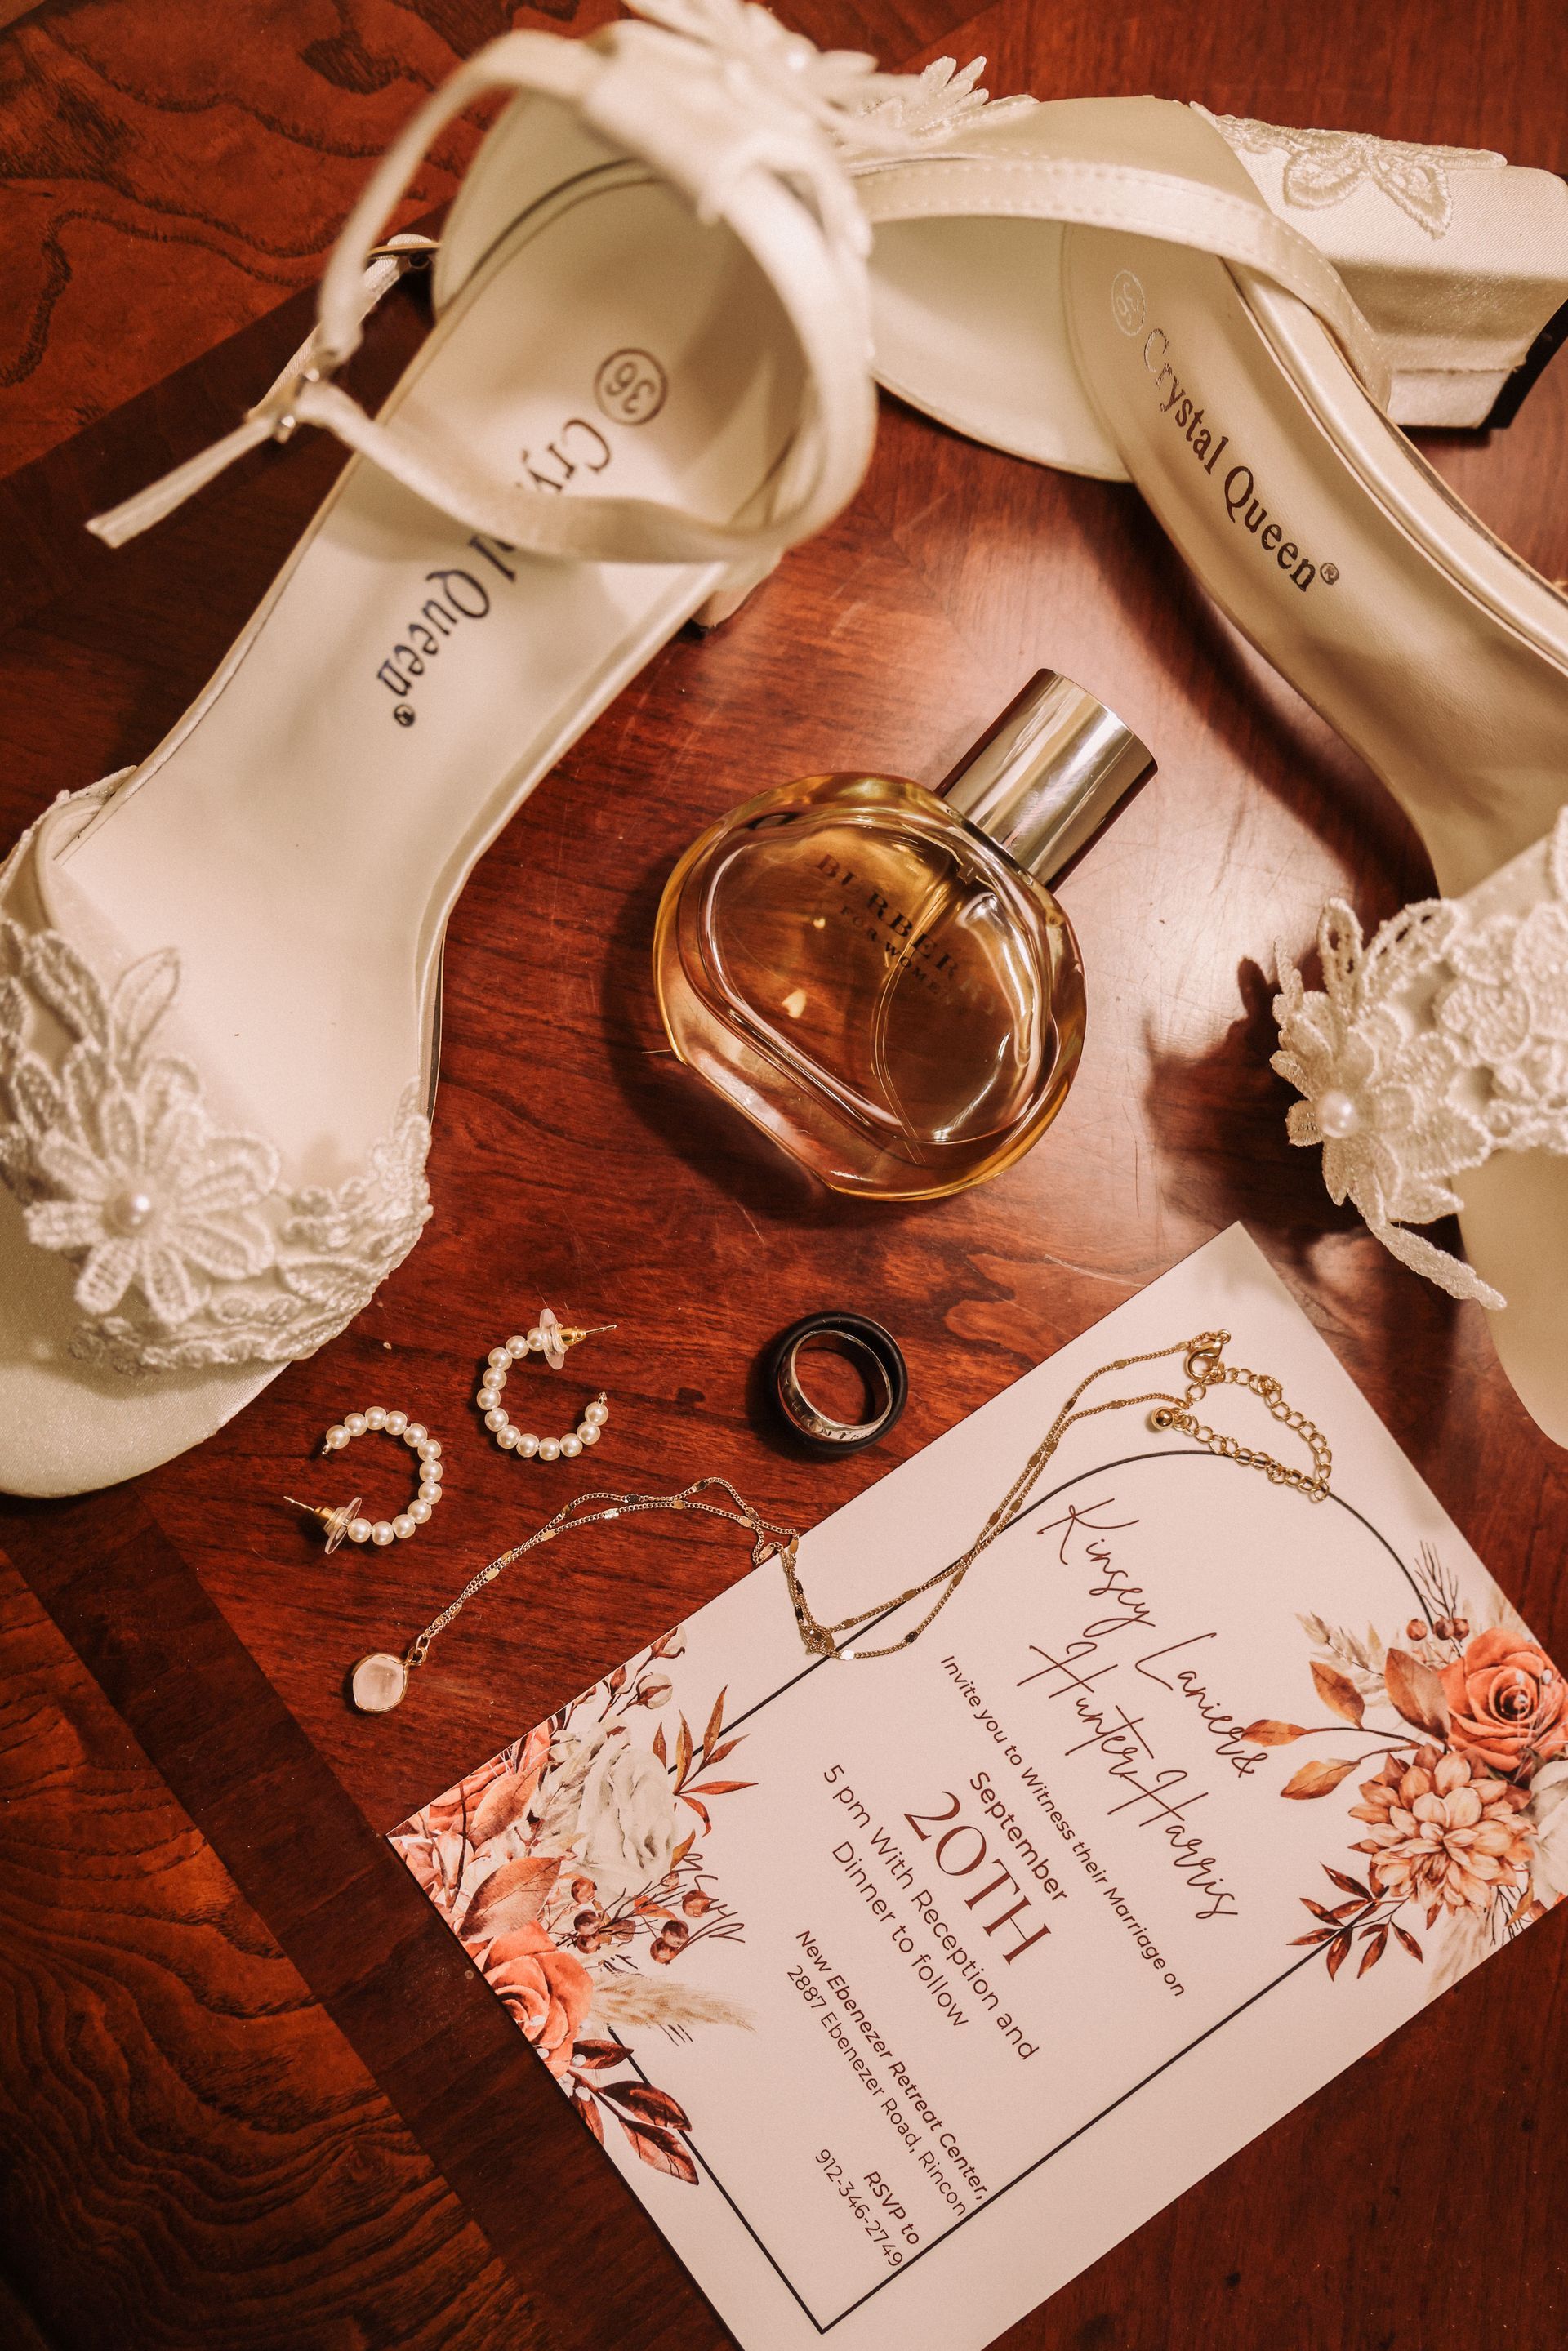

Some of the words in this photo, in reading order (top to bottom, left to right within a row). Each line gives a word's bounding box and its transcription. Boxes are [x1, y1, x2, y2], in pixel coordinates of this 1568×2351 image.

[605, 360, 656, 416] 36
[1143, 327, 1229, 475] Crystal
[468, 419, 611, 583] Cryl
[884, 941, 954, 1005] WOME
[1036, 1498, 1156, 1638] Kinsey
[823, 1764, 845, 1783] 5
[832, 1785, 871, 1829] pm
[940, 1655, 982, 1708] Invite
[973, 1708, 1008, 1744] you
[1004, 1744, 1022, 1766] to
[1020, 1766, 1076, 1841] Witness
[1071, 1841, 1109, 1884] their
[1102, 1886, 1166, 1970] Marriage
[1163, 1972, 1185, 1997] on
[969, 1771, 1068, 1902] September
[1016, 1641, 1155, 1776] Hunter
[1107, 1770, 1238, 1920] Harris
[870, 1826, 914, 1890] With
[903, 1790, 1052, 1966] 20TH
[831, 1841, 897, 1923] Dinner
[891, 1925, 915, 1953] to
[911, 1953, 969, 2027] follow
[911, 1889, 1000, 2011] Reception
[786, 1964, 827, 2009] 2887
[820, 2011, 885, 2096] Ebenezer
[880, 2097, 922, 2153] Road,
[917, 2150, 966, 2217] Rincon
[795, 1930, 833, 1972] New
[826, 1974, 893, 2058] Ebenezer
[887, 2060, 943, 2132] Retreat
[939, 2132, 988, 2201] Center,
[996, 2012, 1040, 2061] and
[815, 2148, 903, 2267] 912-346-2749
[863, 2171, 906, 2220] RSVP
[901, 2223, 920, 2245] to
